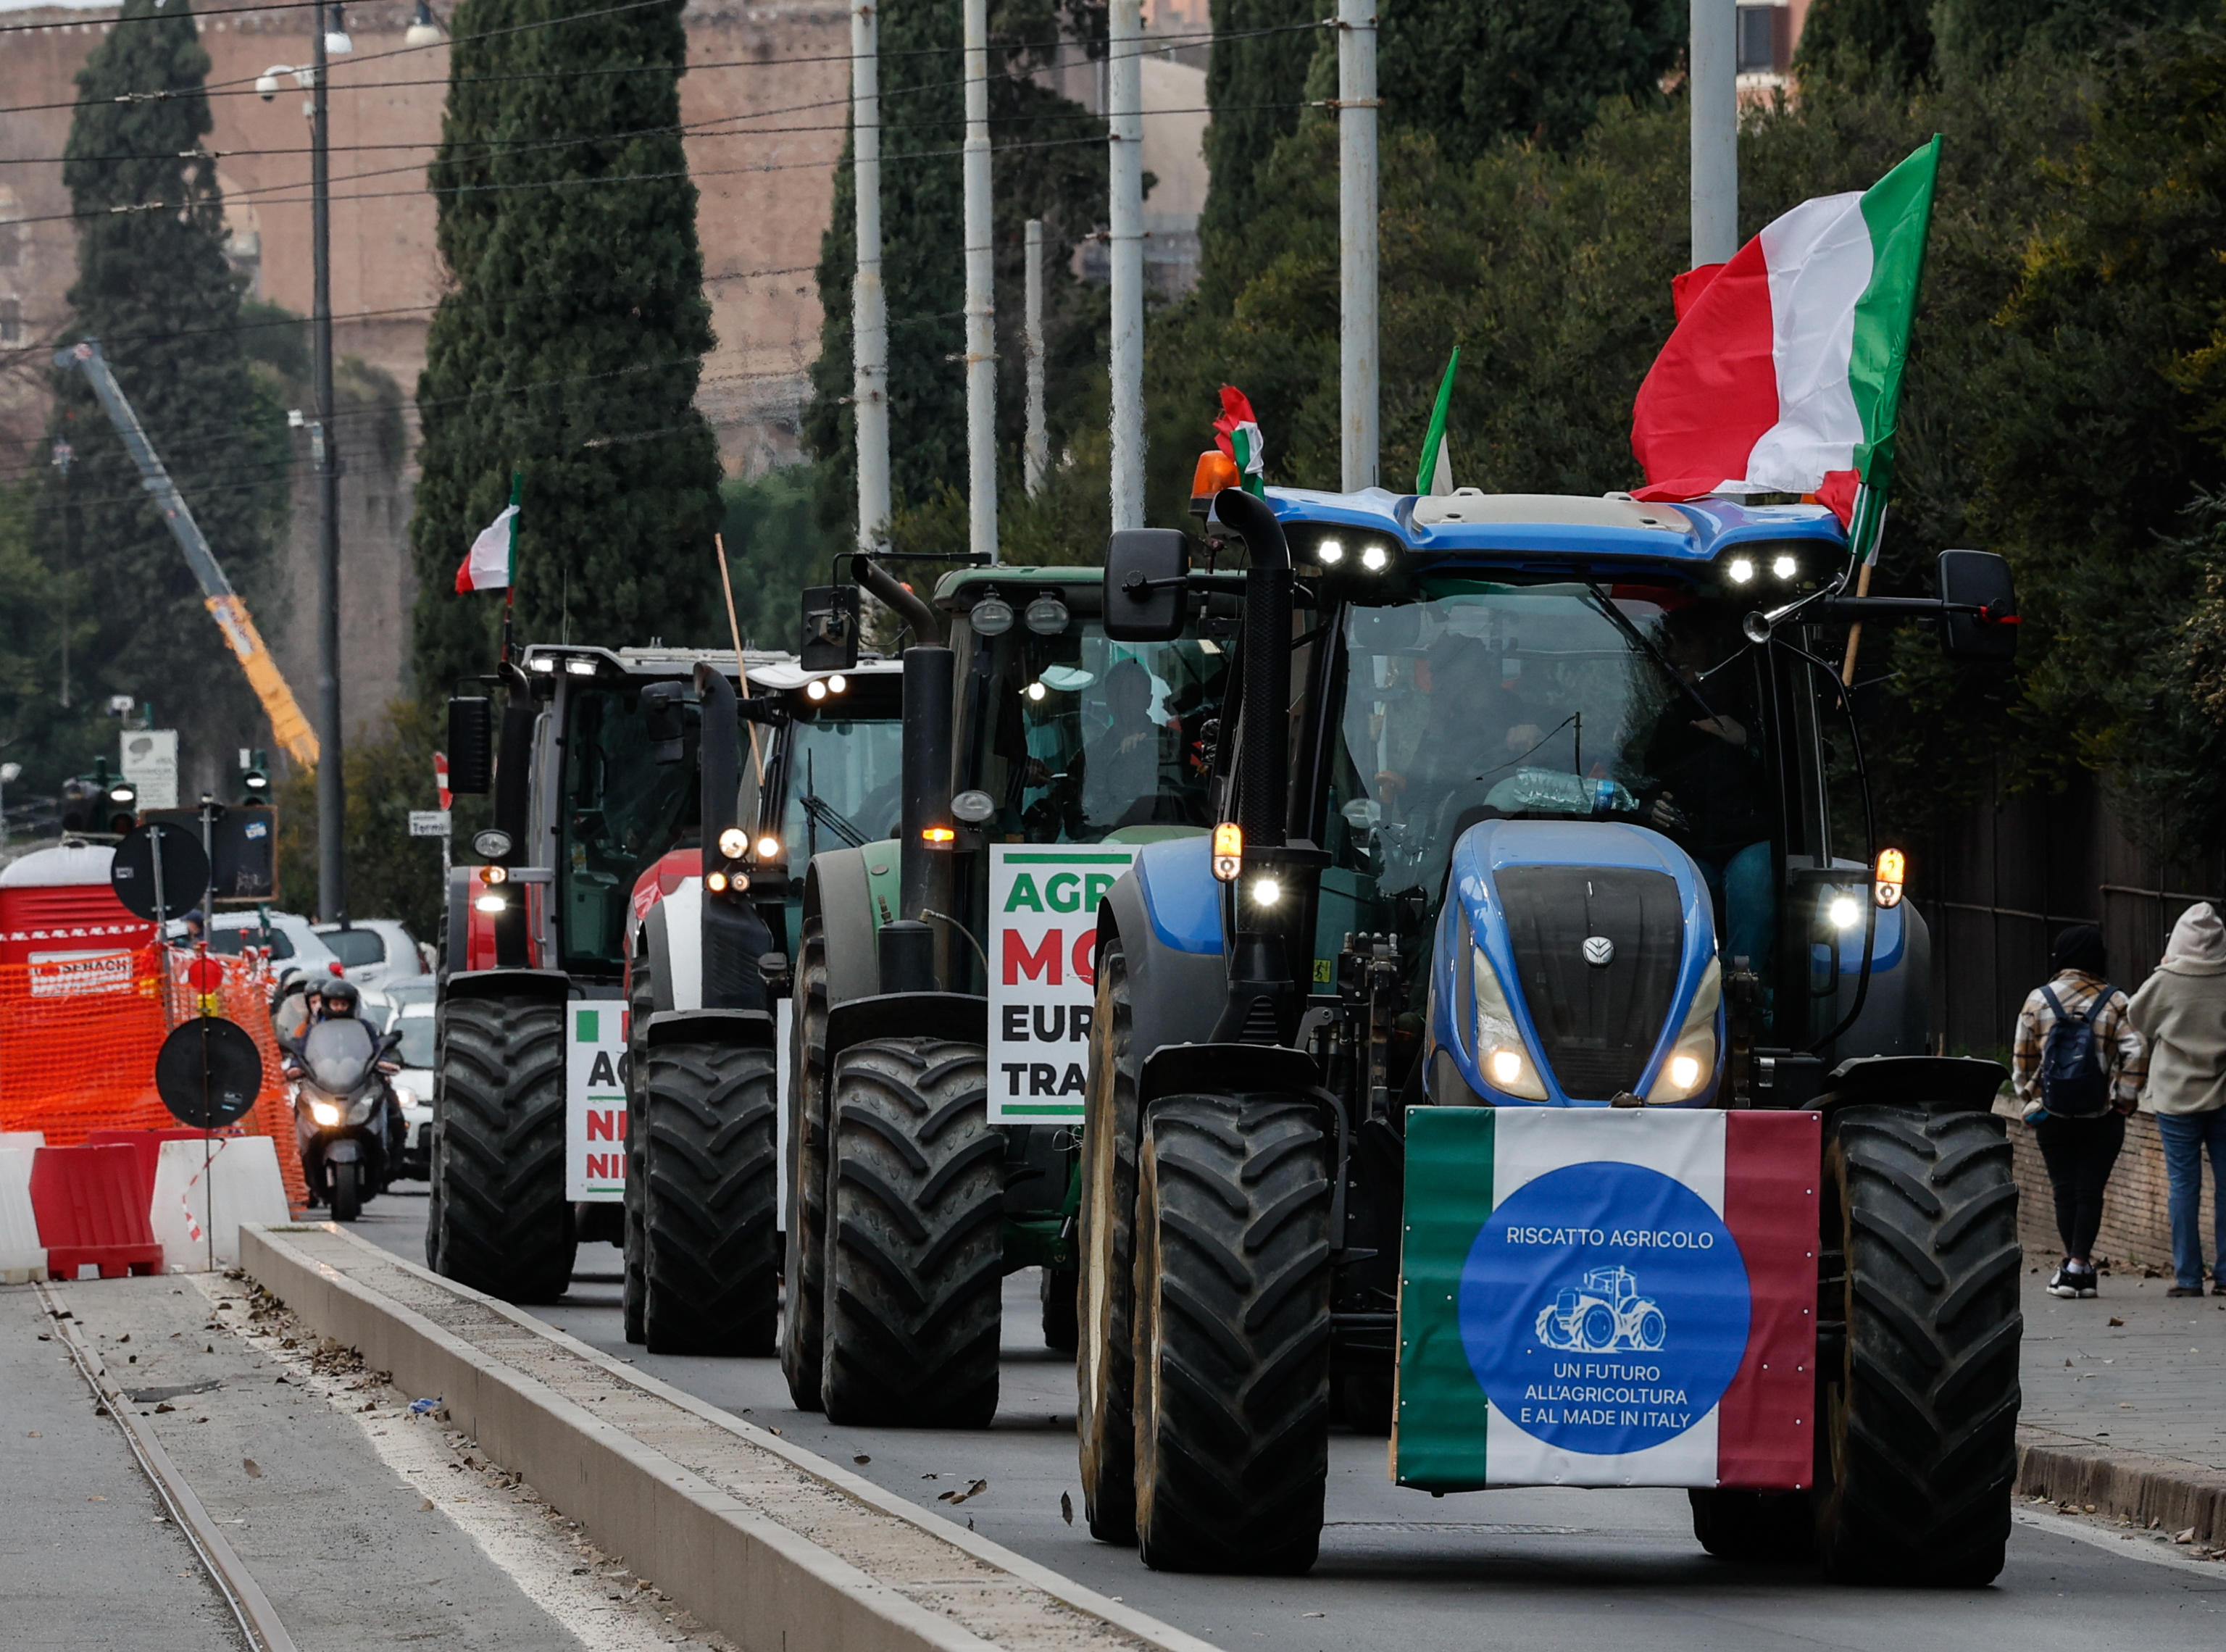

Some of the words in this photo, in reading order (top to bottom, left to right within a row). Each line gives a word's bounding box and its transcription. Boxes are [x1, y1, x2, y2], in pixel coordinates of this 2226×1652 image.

[1506, 1227, 1604, 1246] RISCATTO
[1609, 1230, 1714, 1249] AGRICOLO
[1554, 1363, 1580, 1378] UN
[1585, 1364, 1660, 1381] FUTURO
[1525, 1385, 1688, 1405] ALL'AGRICOLTURA
[1521, 1408, 1531, 1423] E
[1535, 1409, 1558, 1424] AL
[1563, 1409, 1616, 1425] MADE
[1620, 1411, 1638, 1426] IN
[1643, 1412, 1691, 1428] ITALY
